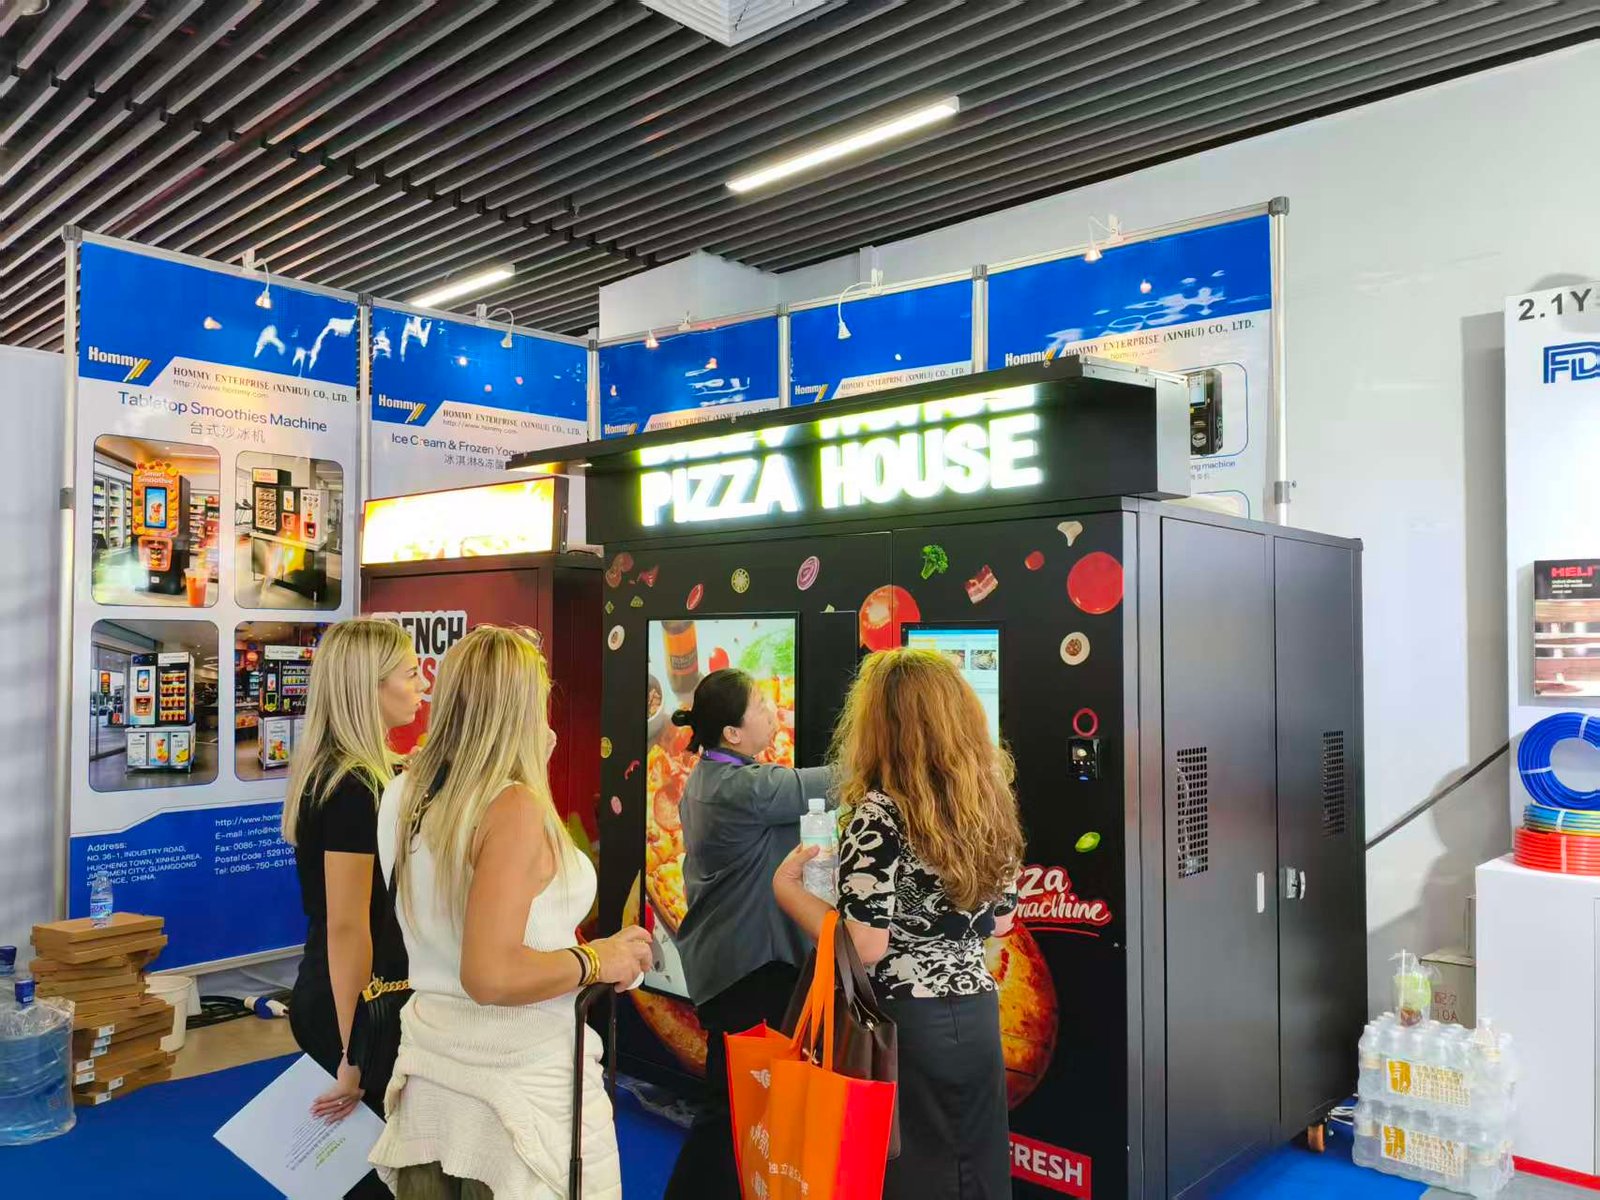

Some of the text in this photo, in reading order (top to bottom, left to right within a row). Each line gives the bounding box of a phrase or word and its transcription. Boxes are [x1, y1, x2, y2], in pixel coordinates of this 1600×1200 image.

[1103, 333, 1159, 350] ENTERPRISE
[1163, 326, 1205, 342] (XINHUI)
[1232, 319, 1254, 331] LTD.
[88, 345, 147, 380] Hommy
[173, 367, 210, 380] HOMMY
[215, 374, 269, 390] ENTERPRISE
[273, 383, 311, 397] (XINHUI)
[332, 392, 349, 403] LTD.
[794, 384, 826, 401] Hommy
[117, 391, 327, 432] Tabletop Smoothies Machine
[378, 394, 423, 422] Hommy
[443, 409, 473, 420] HOMMY
[475, 413, 518, 427] ENTERPRISE
[391, 433, 408, 444] Ice
[410, 434, 446, 450] Cream
[448, 440, 456, 450] &
[458, 441, 494, 455] Frozen
[640, 413, 1042, 527] PIZZA HOUSE
[87, 842, 127, 852] Address:
[124, 848, 162, 858] INDUSTRY
[214, 854, 240, 863] Postal
[266, 847, 295, 858] 529100
[87, 862, 128, 872] HUICHENG
[155, 855, 180, 863] XINHUI
[149, 861, 197, 872] GUANGDONG
